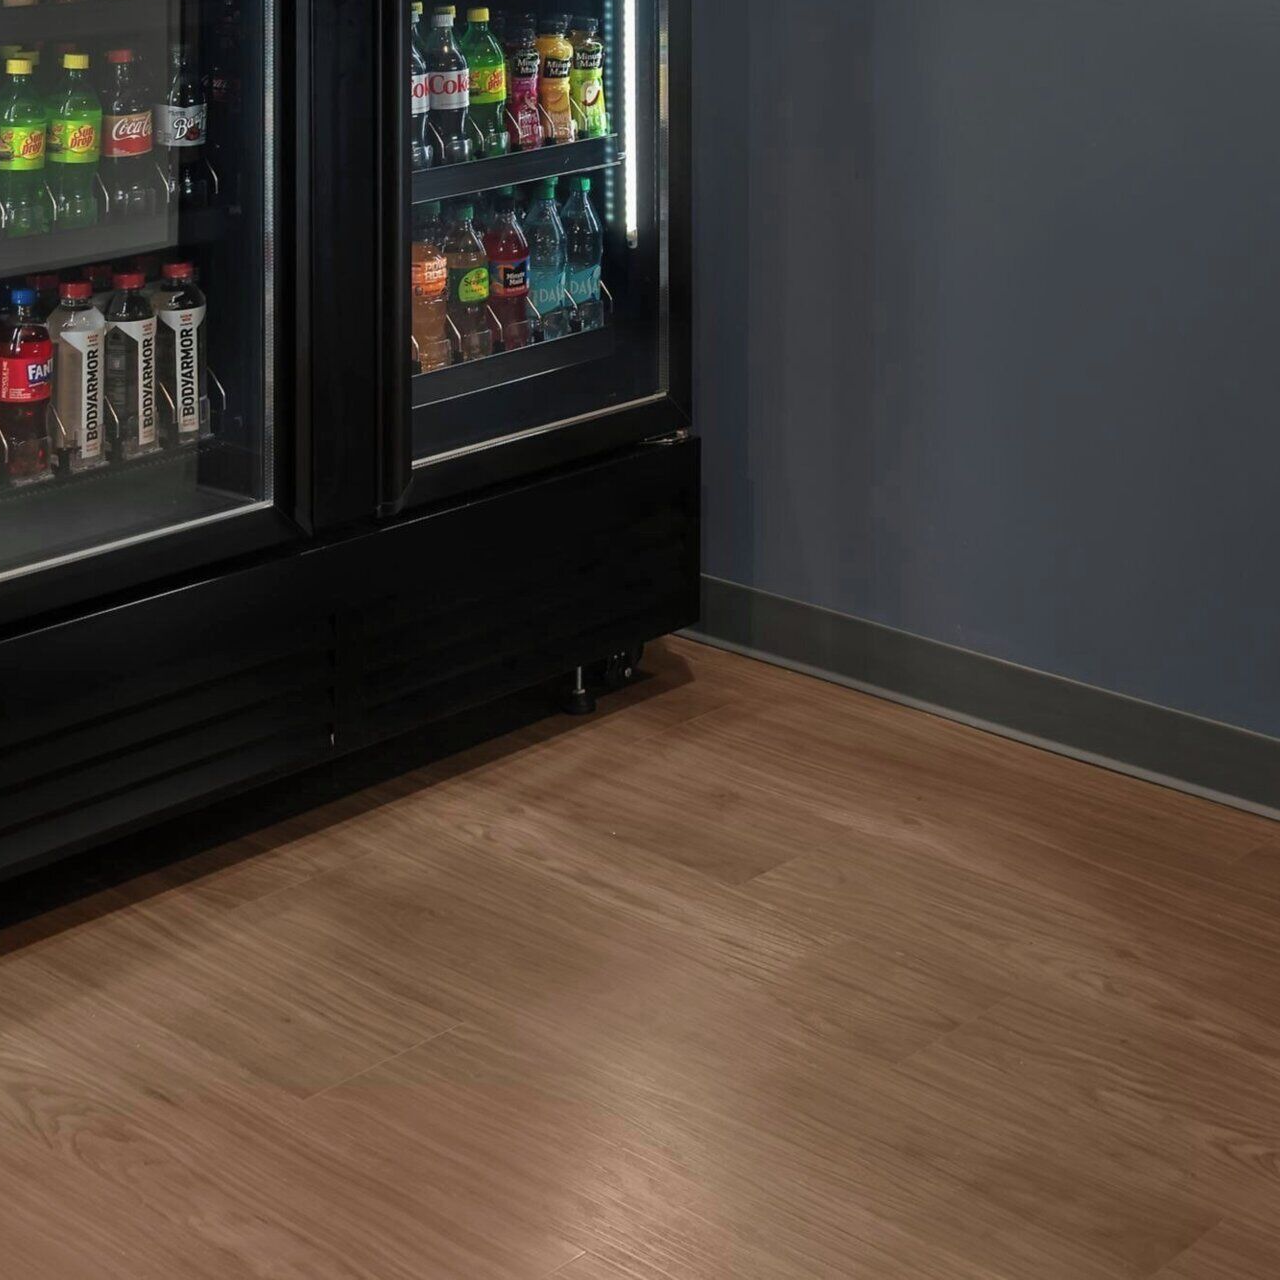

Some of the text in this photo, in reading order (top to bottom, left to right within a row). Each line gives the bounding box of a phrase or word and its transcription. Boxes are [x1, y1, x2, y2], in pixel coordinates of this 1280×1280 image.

[28, 131, 44, 144] Sun
[77, 125, 94, 138] Sun
[22, 142, 43, 155] Drop
[70, 135, 93, 149] Drop
[180, 327, 195, 417] BODYARMOR
[142, 338, 153, 428] BODYARMOR
[86, 349, 99, 441] BODYARMOR
